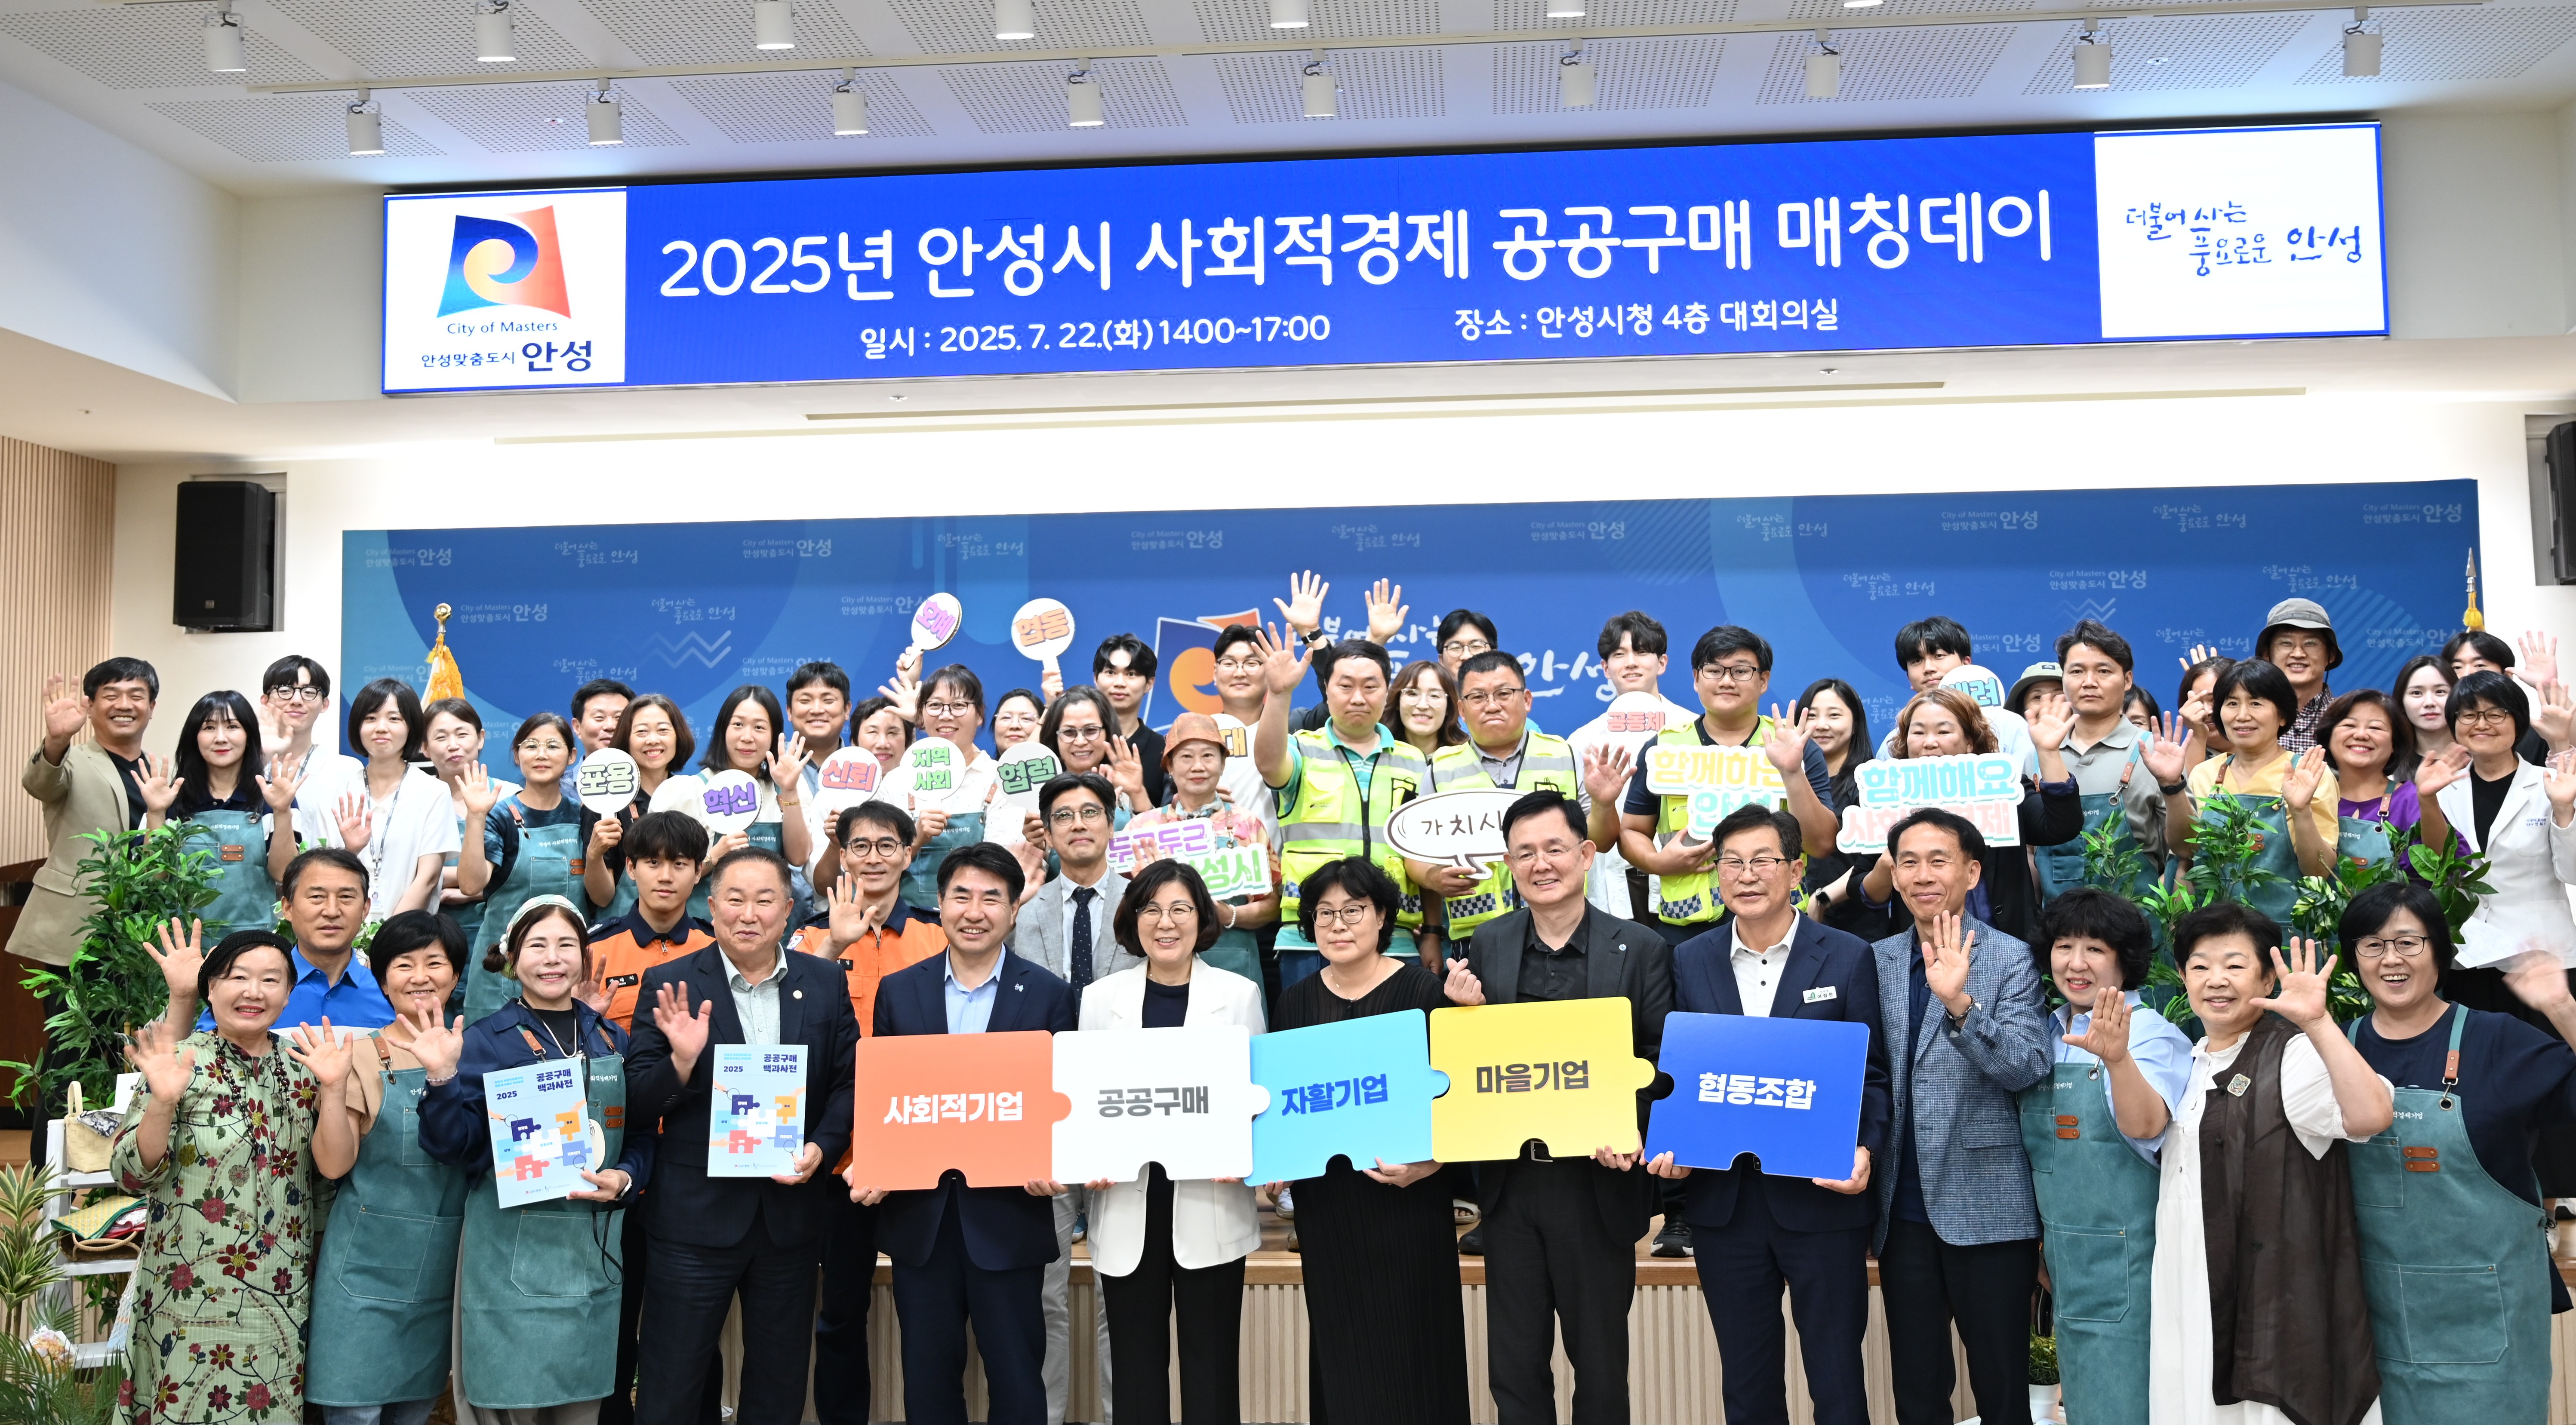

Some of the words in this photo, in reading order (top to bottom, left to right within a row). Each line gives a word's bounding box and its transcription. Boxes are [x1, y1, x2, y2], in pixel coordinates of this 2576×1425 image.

[2127, 203, 2185, 239] 더불어
[2194, 202, 2246, 222] 사는
[661, 230, 894, 300] 2025년
[919, 221, 1110, 298] 안성시
[1136, 209, 1468, 288] 사회적경제
[1493, 200, 1751, 280] 공공구매
[1778, 190, 2051, 269] 매칭데이
[2190, 227, 2272, 276] 풍요로운
[2288, 226, 2361, 263] 안성
[448, 323, 475, 336] City
[481, 322, 495, 333] of
[501, 322, 557, 333] Masters
[1455, 309, 1512, 341] 장소
[1537, 304, 1652, 338] 안성시청
[1662, 302, 1710, 334] 4층
[1720, 298, 1837, 331] 대회의실
[861, 327, 914, 359] 일시
[940, 325, 1021, 352] 2025.
[1028, 324, 1049, 350] 7.
[422, 352, 514, 367] 안성맞춤도시
[522, 341, 591, 372] 안성
[1942, 511, 1955, 519] City
[1942, 521, 1997, 531] 안성맞춤도시
[2000, 511, 2038, 529] 안성
[2217, 513, 2246, 528] 안성
[2364, 513, 2420, 524] 안성맞춤도시
[2423, 504, 2462, 523] 안성
[1531, 531, 1585, 541] 안성맞춤도시
[1588, 521, 1625, 540] 안성
[1799, 523, 1828, 537] 안성
[743, 548, 793, 558] 안성맞춤도시
[797, 539, 831, 557] 안성
[997, 541, 1023, 555] 안성
[1132, 541, 1184, 550] 안성맞춤도시
[1187, 531, 1223, 549] 안성
[1392, 533, 1419, 547] 안성
[366, 549, 378, 557] City
[366, 558, 415, 567] 안성맞춤도시
[418, 548, 452, 566] 안성
[612, 550, 638, 562] 안성
[2050, 570, 2064, 578] City
[2050, 580, 2105, 590] 안성맞춤도시
[2108, 570, 2147, 589] 안성
[2328, 574, 2357, 588] 안성
[1906, 581, 1934, 596] 안성
[461, 604, 473, 612] City
[461, 613, 510, 623] 안성맞춤도시
[513, 603, 548, 622] 안성
[710, 606, 736, 619] 안성
[842, 605, 892, 615] 안성맞춤도시
[1016, 608, 1070, 647] 협동
[2002, 634, 2040, 653] 안성
[2220, 638, 2250, 652] 안성
[2367, 637, 2423, 648] 안성맞춤도시
[611, 667, 637, 680] 안성
[743, 666, 793, 676] 안성맞춤도시
[1607, 711, 1665, 731] 공동체
[913, 746, 950, 768] 지역
[580, 762, 635, 796] 포용
[822, 759, 877, 792] 신뢰
[914, 769, 951, 791] 사회
[997, 756, 1057, 795] 협력
[1862, 760, 2015, 802] 함께해요
[704, 782, 757, 817] 혁신
[764, 1054, 797, 1063] 공공구매
[536, 1069, 571, 1082] 공공구매
[763, 1064, 797, 1073] 백과사전
[1476, 1060, 1589, 1094] 마을기업
[496, 1090, 517, 1100] 2025
[538, 1079, 573, 1092] 백과사전
[1281, 1074, 1389, 1116] 자활기업
[1698, 1072, 1816, 1110] 협동조합
[883, 1091, 1023, 1125] 사회적기업
[1098, 1085, 1209, 1117] 공공구매
